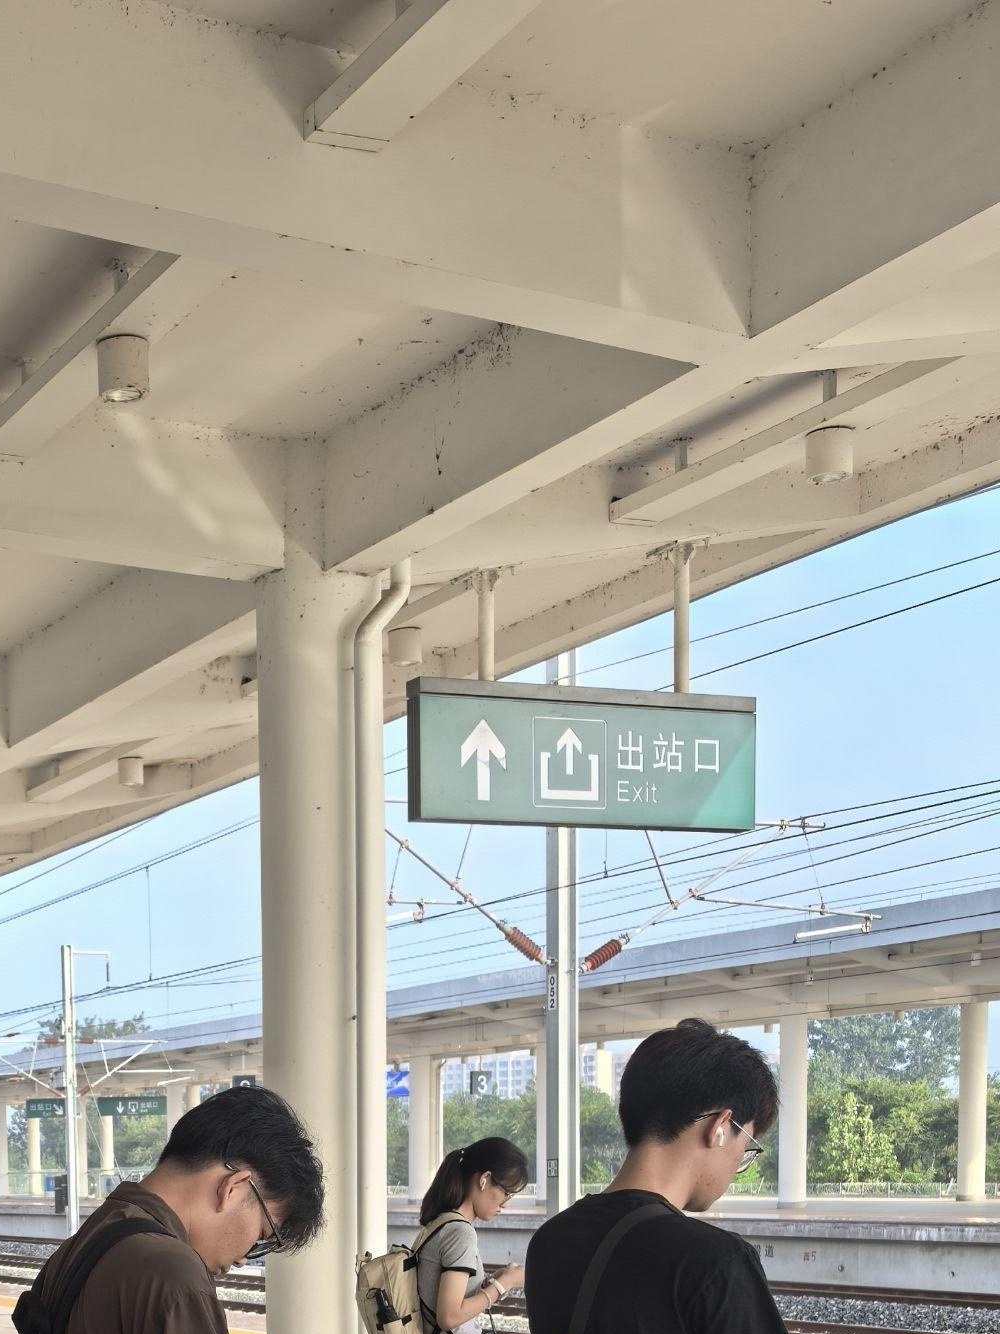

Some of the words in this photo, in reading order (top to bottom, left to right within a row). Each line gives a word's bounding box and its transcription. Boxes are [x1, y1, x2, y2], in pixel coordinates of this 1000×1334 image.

[616, 730, 721, 774] 出站口
[616, 780, 658, 804] Exit
[477, 1075, 488, 1093] 3
